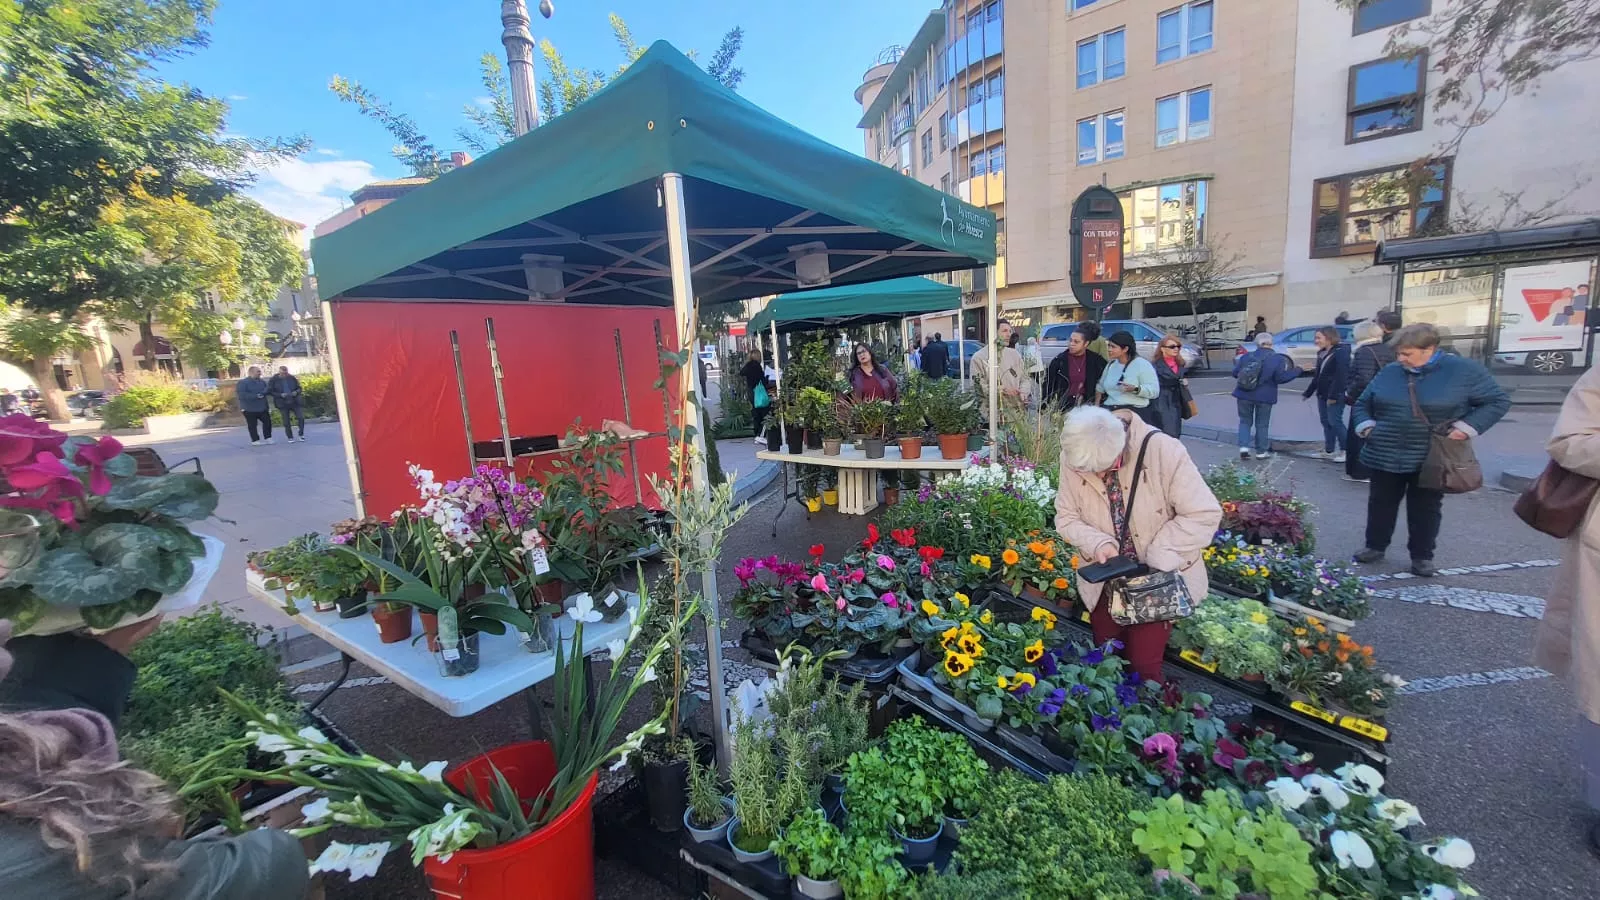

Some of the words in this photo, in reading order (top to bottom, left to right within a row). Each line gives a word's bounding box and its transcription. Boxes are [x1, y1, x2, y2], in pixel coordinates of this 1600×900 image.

[965, 221, 984, 239] Huesca
[1083, 230, 1096, 238] CON
[1097, 230, 1119, 238] TIEMPO
